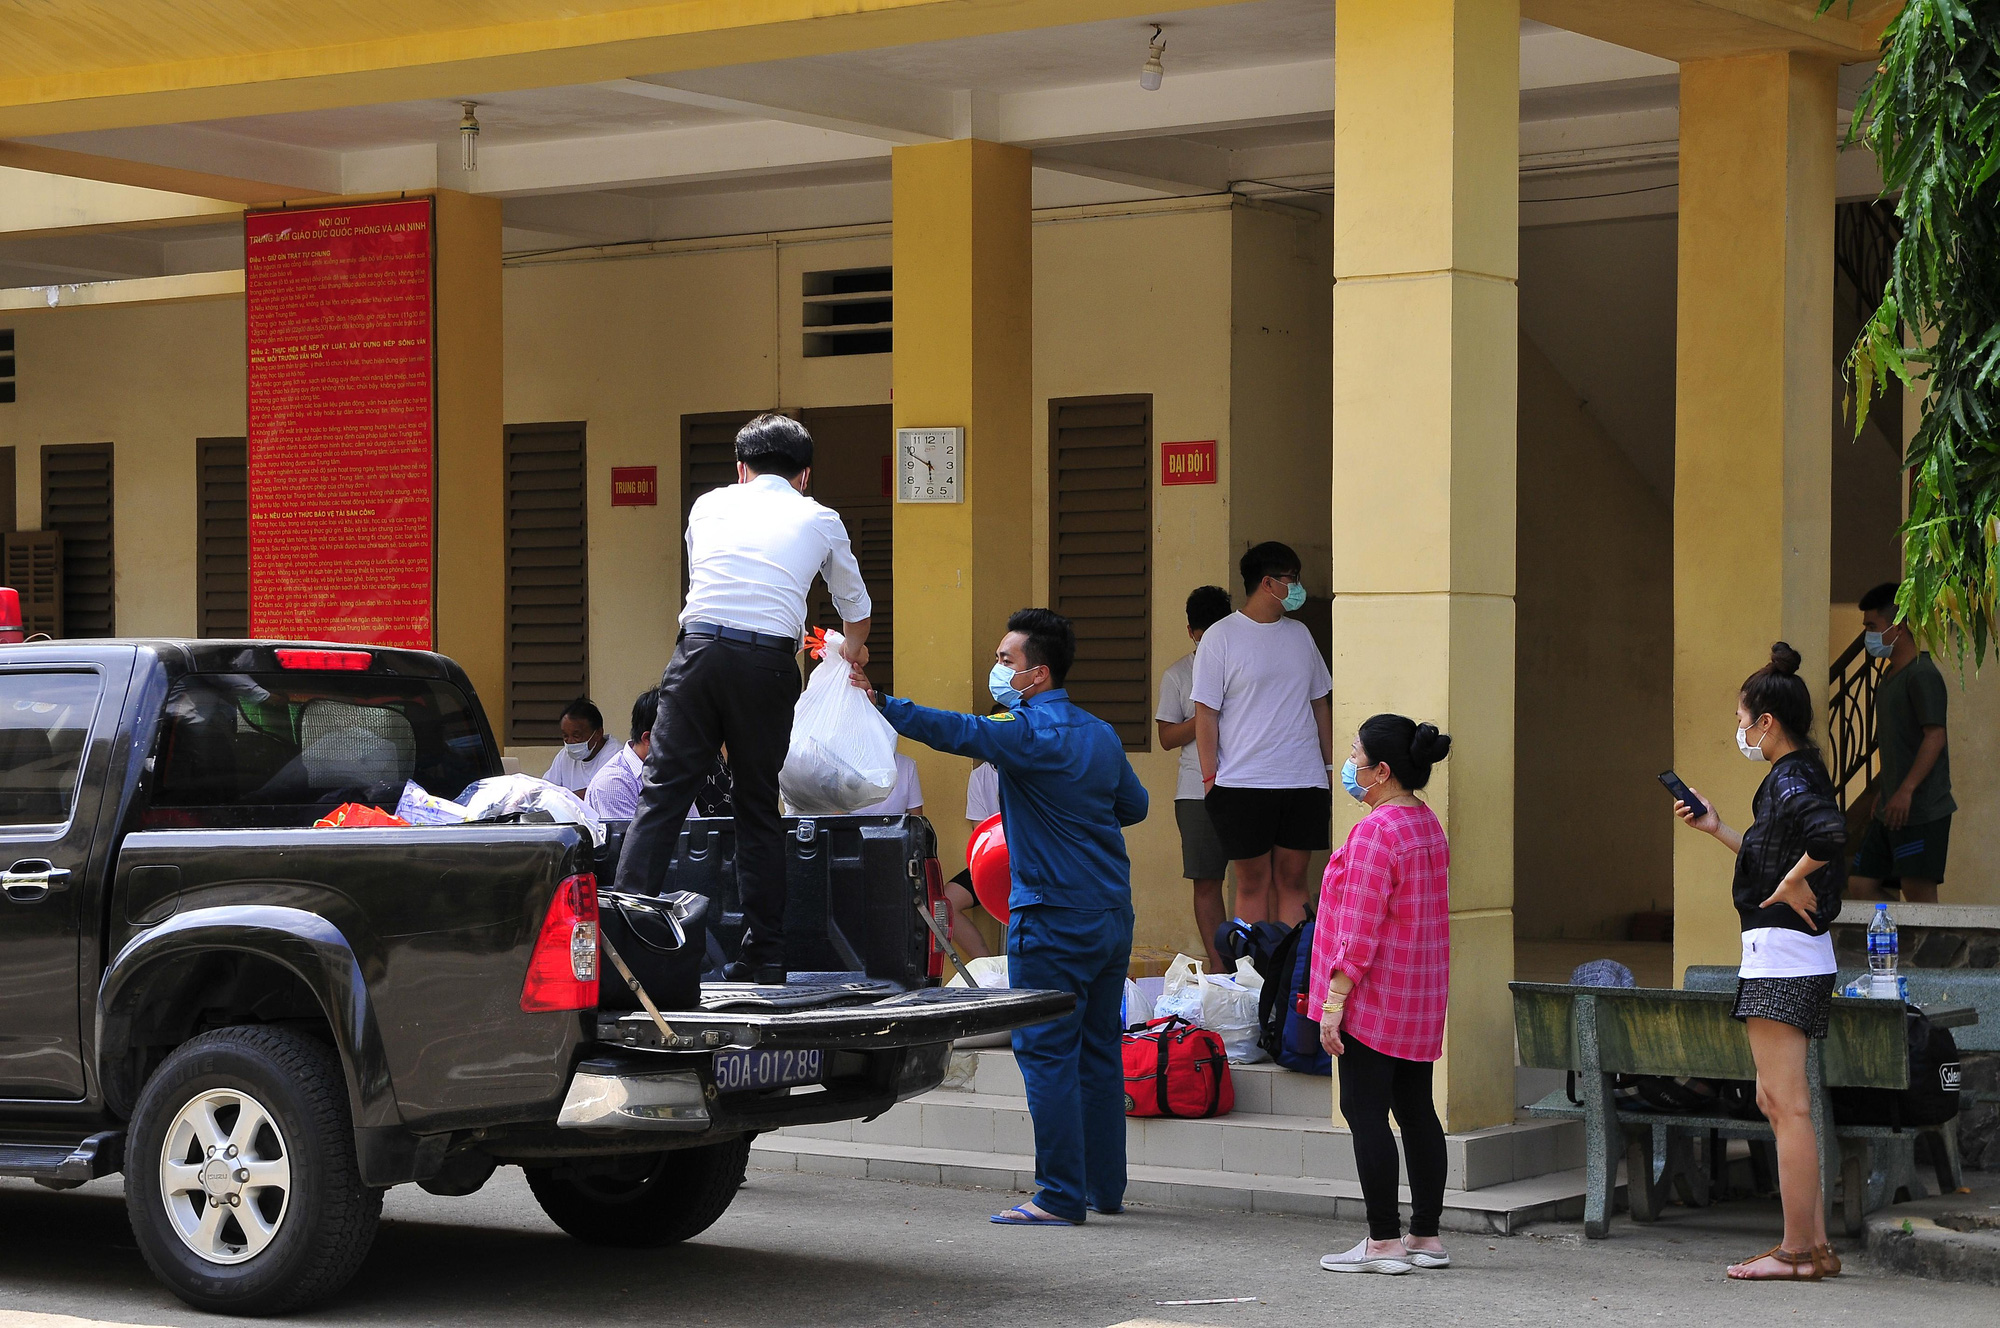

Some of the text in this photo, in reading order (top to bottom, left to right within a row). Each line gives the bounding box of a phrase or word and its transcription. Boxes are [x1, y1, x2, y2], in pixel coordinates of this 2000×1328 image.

[334, 216, 350, 226] QUY
[250, 234, 274, 245] TRUNG
[292, 230, 311, 241] GIÁO
[312, 230, 328, 241] DỤC
[354, 224, 380, 236] PHÒNG
[382, 222, 392, 233] VÀ
[394, 224, 406, 232] AN
[408, 222, 426, 232] NINH
[310, 250, 331, 258] CHUNG
[914, 436, 920, 444] 11
[925, 436, 935, 444] 12
[906, 446, 915, 454] 10
[946, 446, 953, 454] 2
[907, 461, 914, 469] 9
[946, 461, 953, 469] 3
[1169, 449, 1210, 477] ĐẠI ĐỘI 1
[907, 476, 914, 484] 8
[946, 476, 953, 484] 4
[615, 478, 654, 496] TRUNG ĐỘI 1
[359, 508, 376, 516] CÔNG
[716, 1049, 820, 1089] 50A-012.89
